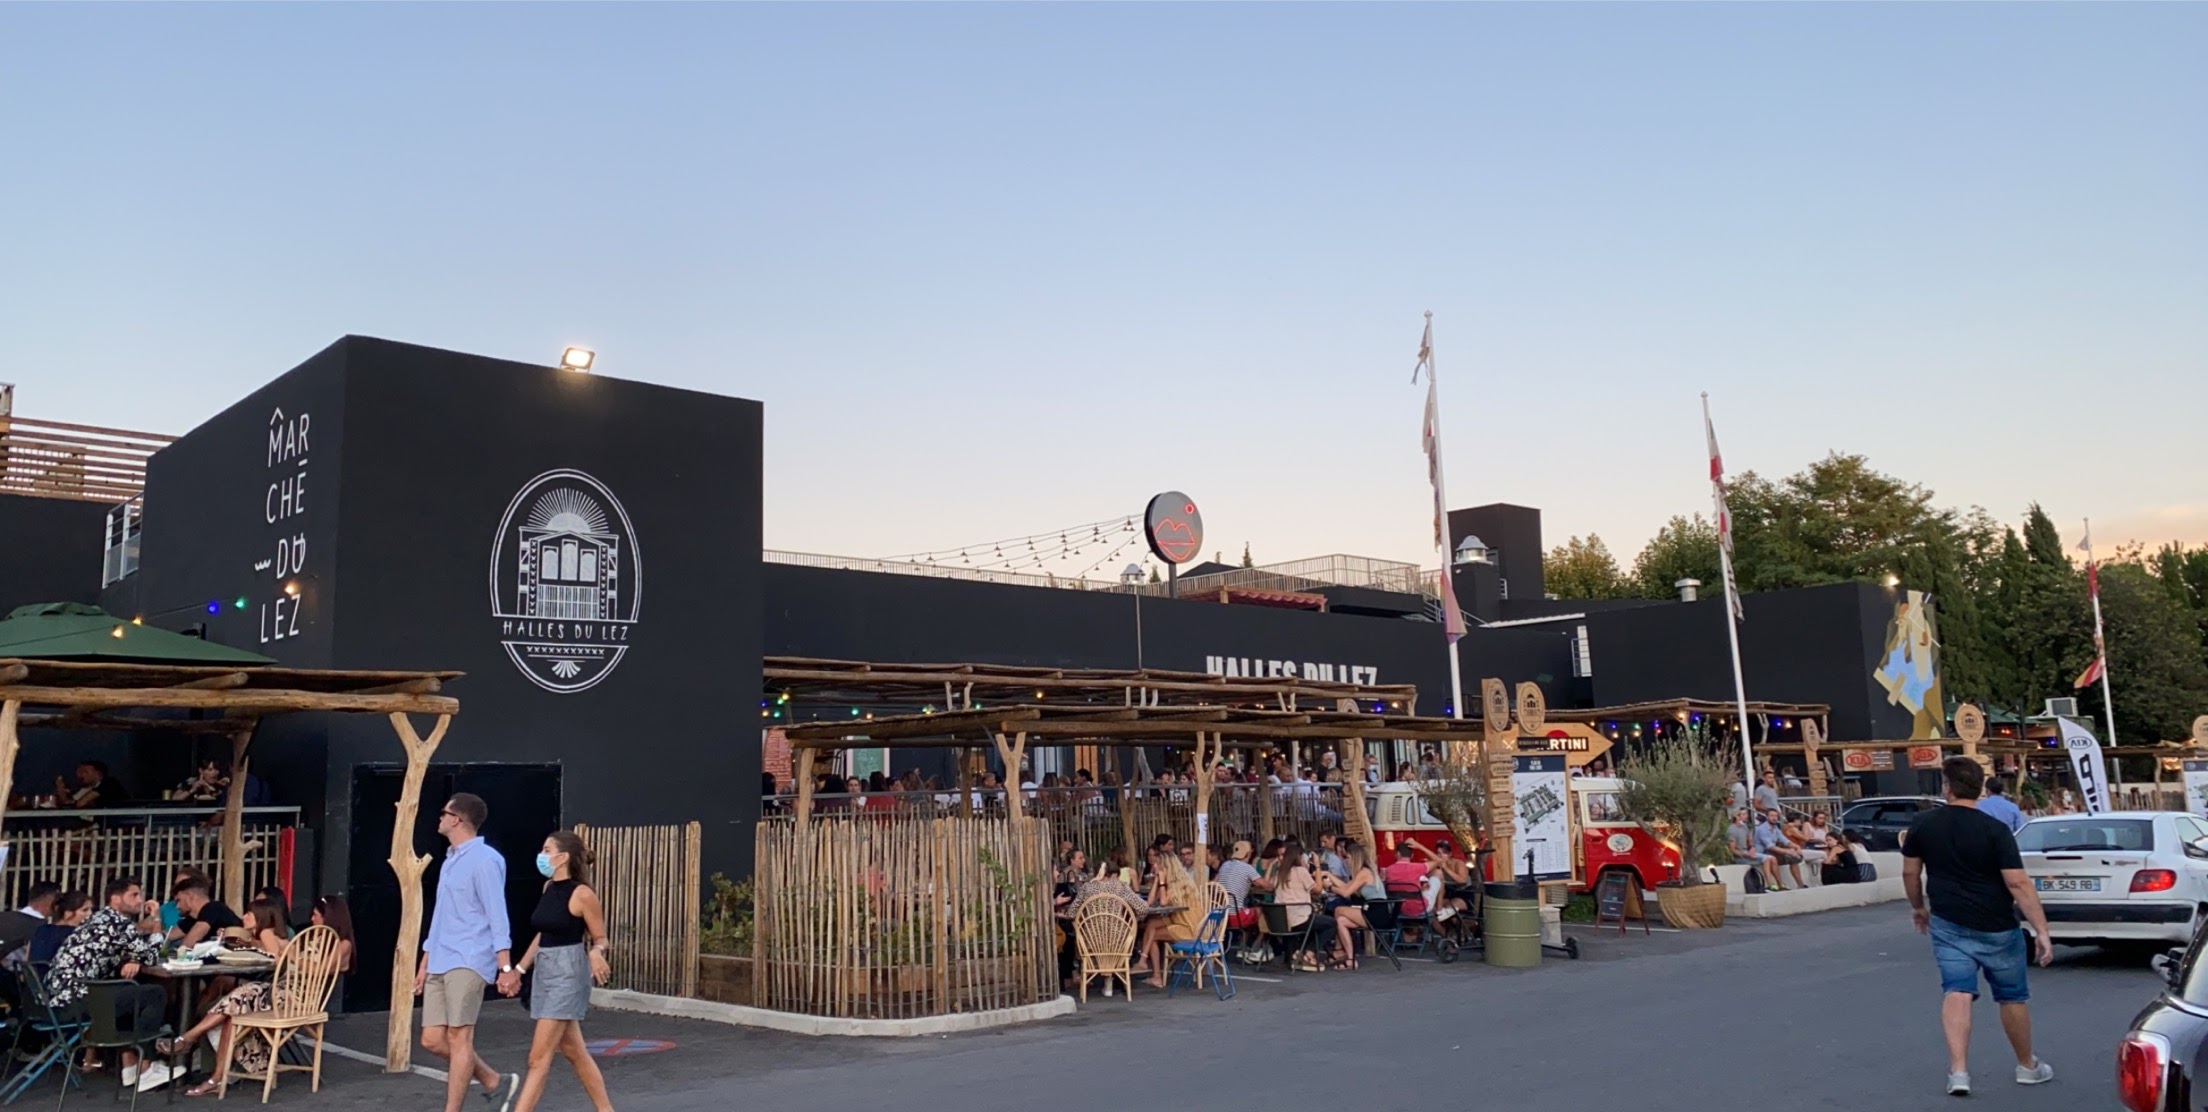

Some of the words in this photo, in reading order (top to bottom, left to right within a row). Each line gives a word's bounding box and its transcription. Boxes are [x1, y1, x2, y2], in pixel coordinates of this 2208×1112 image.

[276, 533, 306, 579] DU
[260, 594, 301, 643] LEZ
[503, 621, 565, 639] HALLES
[574, 624, 593, 639] DU
[602, 626, 629, 640] LEZ
[1536, 738, 1588, 751] RTINI
[1849, 754, 1868, 765] KIA
